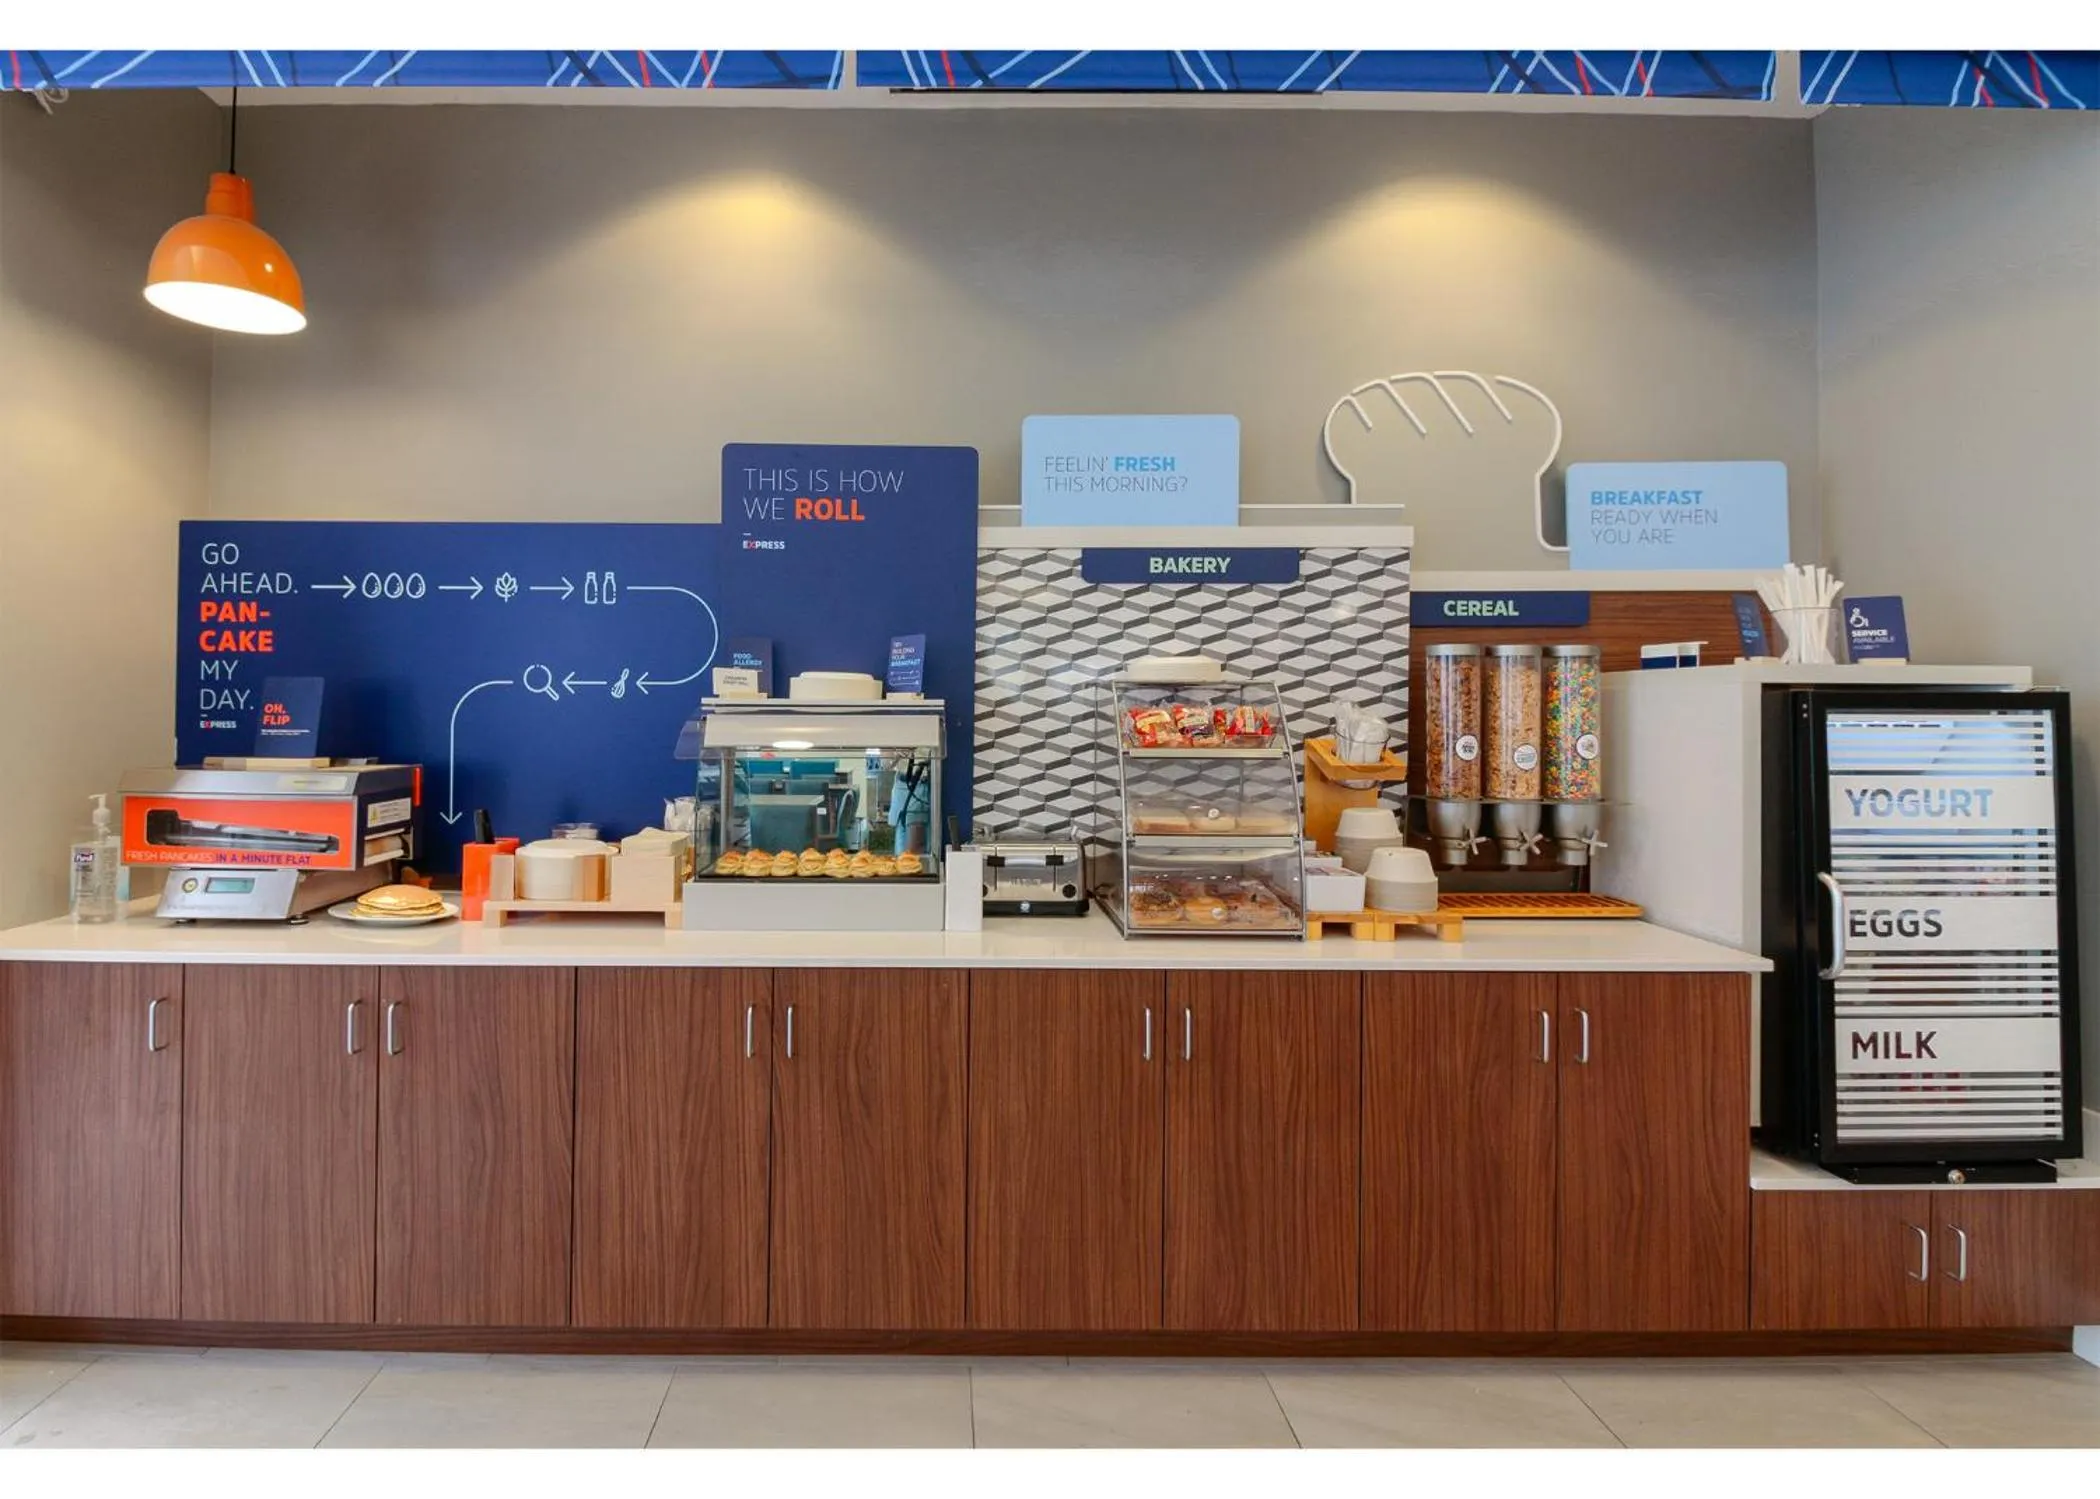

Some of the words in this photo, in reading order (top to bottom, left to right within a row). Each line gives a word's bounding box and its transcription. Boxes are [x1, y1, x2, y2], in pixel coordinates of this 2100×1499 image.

[1044, 456, 1109, 473] FEELIN'
[1114, 456, 1175, 472] FRESH
[743, 468, 799, 492] THIS
[809, 469, 829, 492] IS
[839, 470, 904, 493] HOW
[1044, 476, 1083, 493] THIS
[1090, 476, 1188, 493] MORNING?
[1590, 490, 1704, 505] BREAKFAST
[743, 497, 785, 520] WE
[795, 498, 865, 521] ROLL
[1590, 509, 1653, 526] READY
[1660, 509, 1718, 525] WHEN
[1592, 528, 1631, 544] YOU
[1637, 528, 1675, 544] ARE
[202, 542, 240, 565] GO
[742, 540, 785, 550] EXPRESS
[1150, 557, 1231, 574] BAKERY
[201, 572, 299, 594] AHEAD.
[200, 601, 270, 623] PAN-
[1443, 600, 1519, 616] CEREAL
[199, 630, 273, 652] CAKE
[1851, 629, 1888, 638] SERVICE
[200, 659, 238, 681] MY
[200, 688, 254, 710] DAY.
[199, 720, 237, 729] EXPRESS
[262, 714, 291, 725] FLIP
[1845, 788, 1993, 817] YOGURT
[126, 850, 158, 861] FRESH
[160, 851, 215, 862] PANCAKES
[216, 853, 227, 863] IN
[230, 853, 238, 863] A
[242, 853, 283, 864] MINUTE
[286, 854, 312, 865] FLAT
[1849, 909, 1943, 937] EGGS
[1851, 1031, 1937, 1059] MILK
